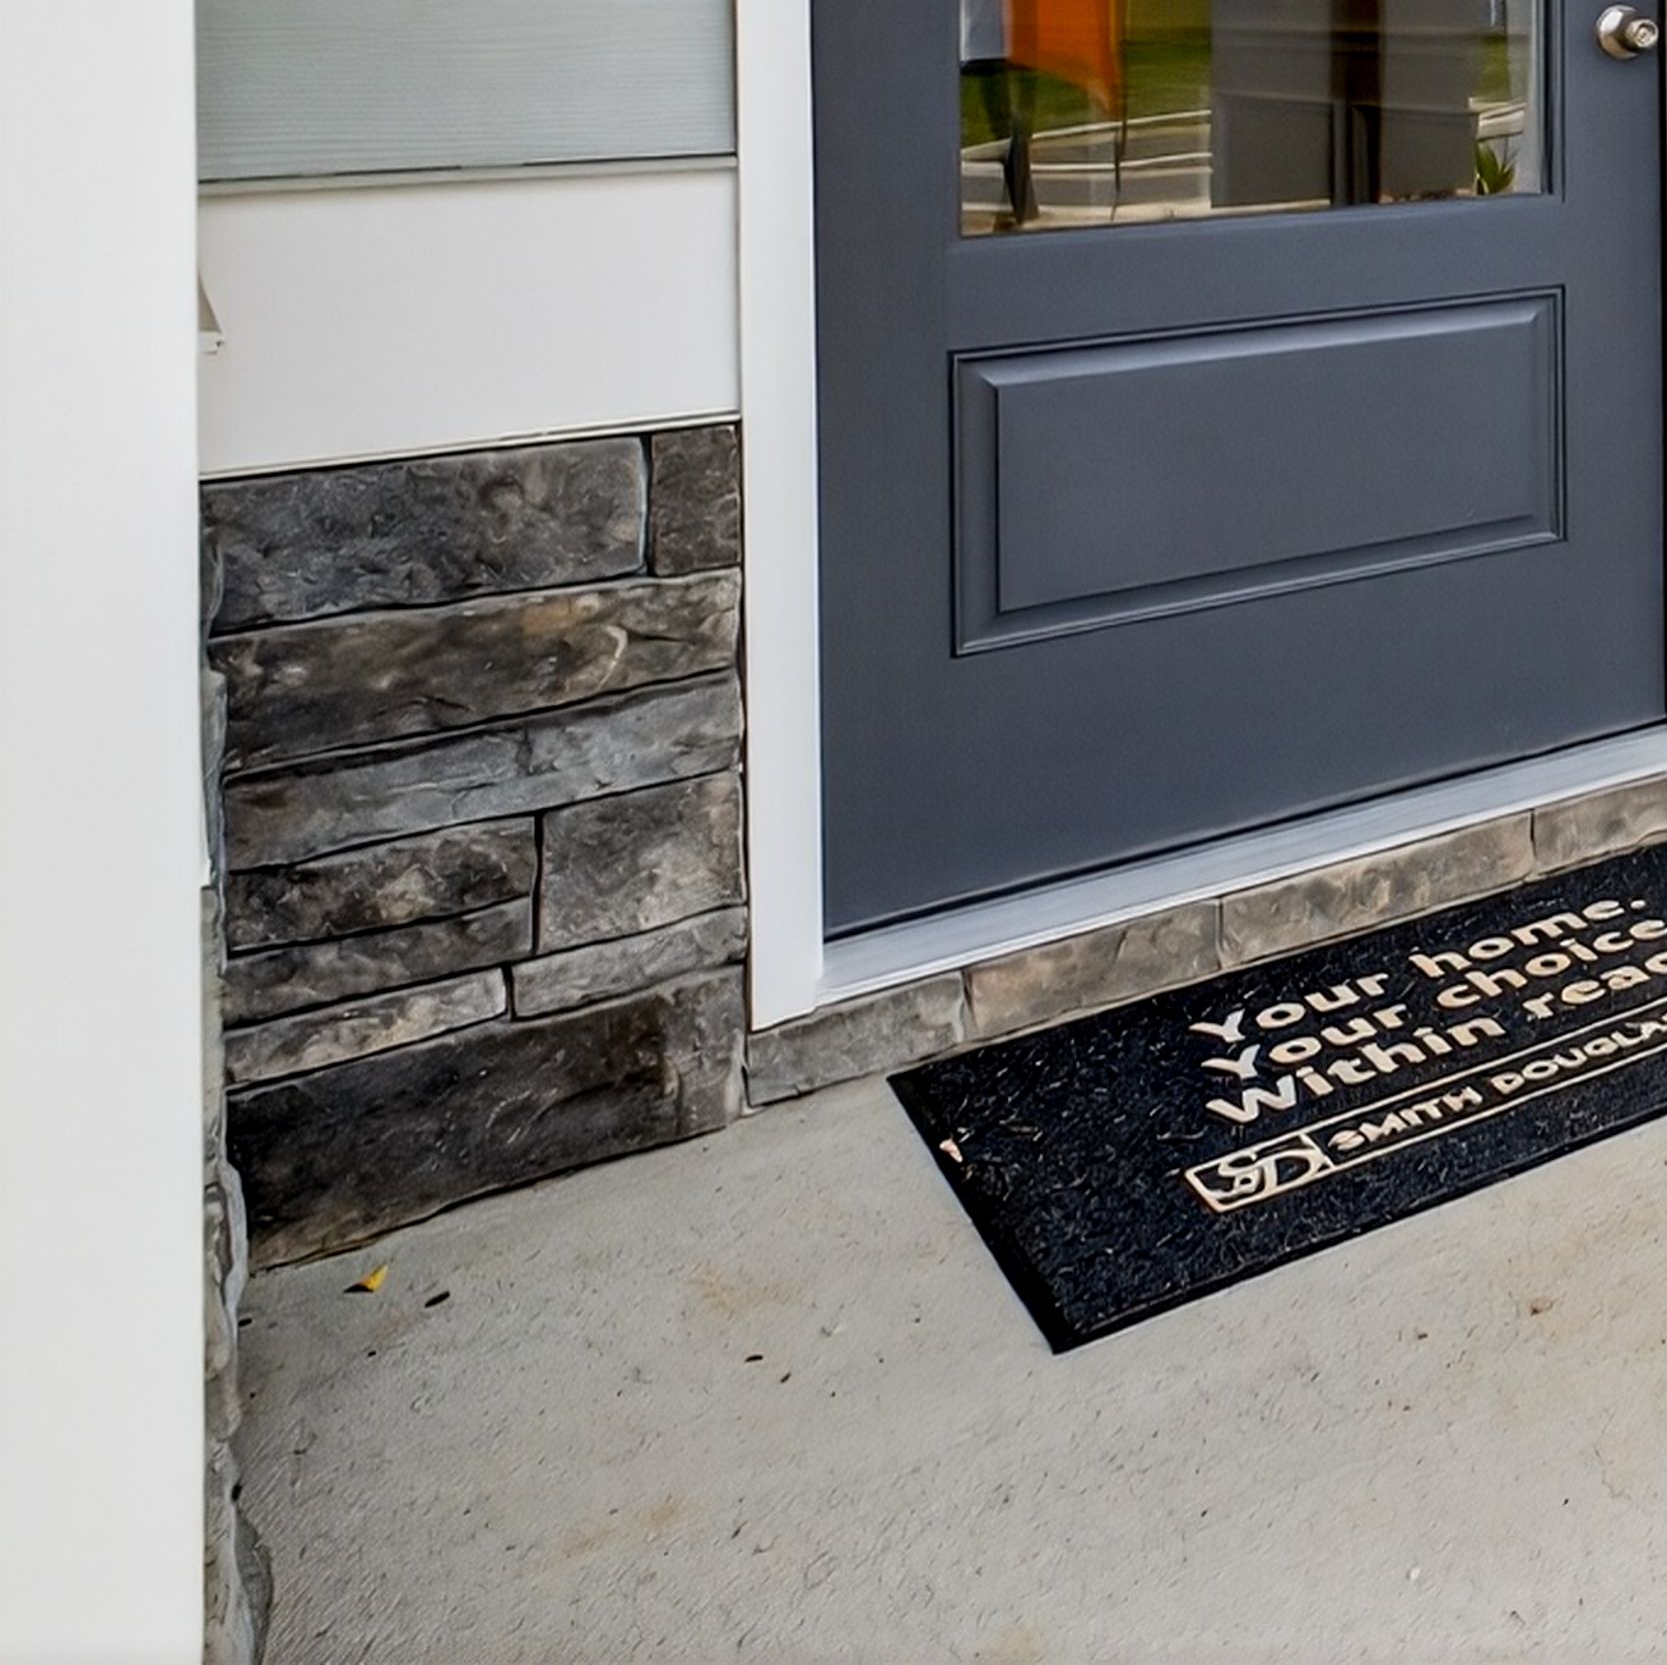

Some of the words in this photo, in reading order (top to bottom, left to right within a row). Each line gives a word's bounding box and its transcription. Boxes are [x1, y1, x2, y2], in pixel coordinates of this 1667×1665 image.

[1189, 972, 1389, 1043] Your
[1408, 899, 1646, 978] home.
[1200, 1003, 1407, 1080] Your
[1205, 1017, 1506, 1123] Within
[1328, 1085, 1483, 1151] SMITH
